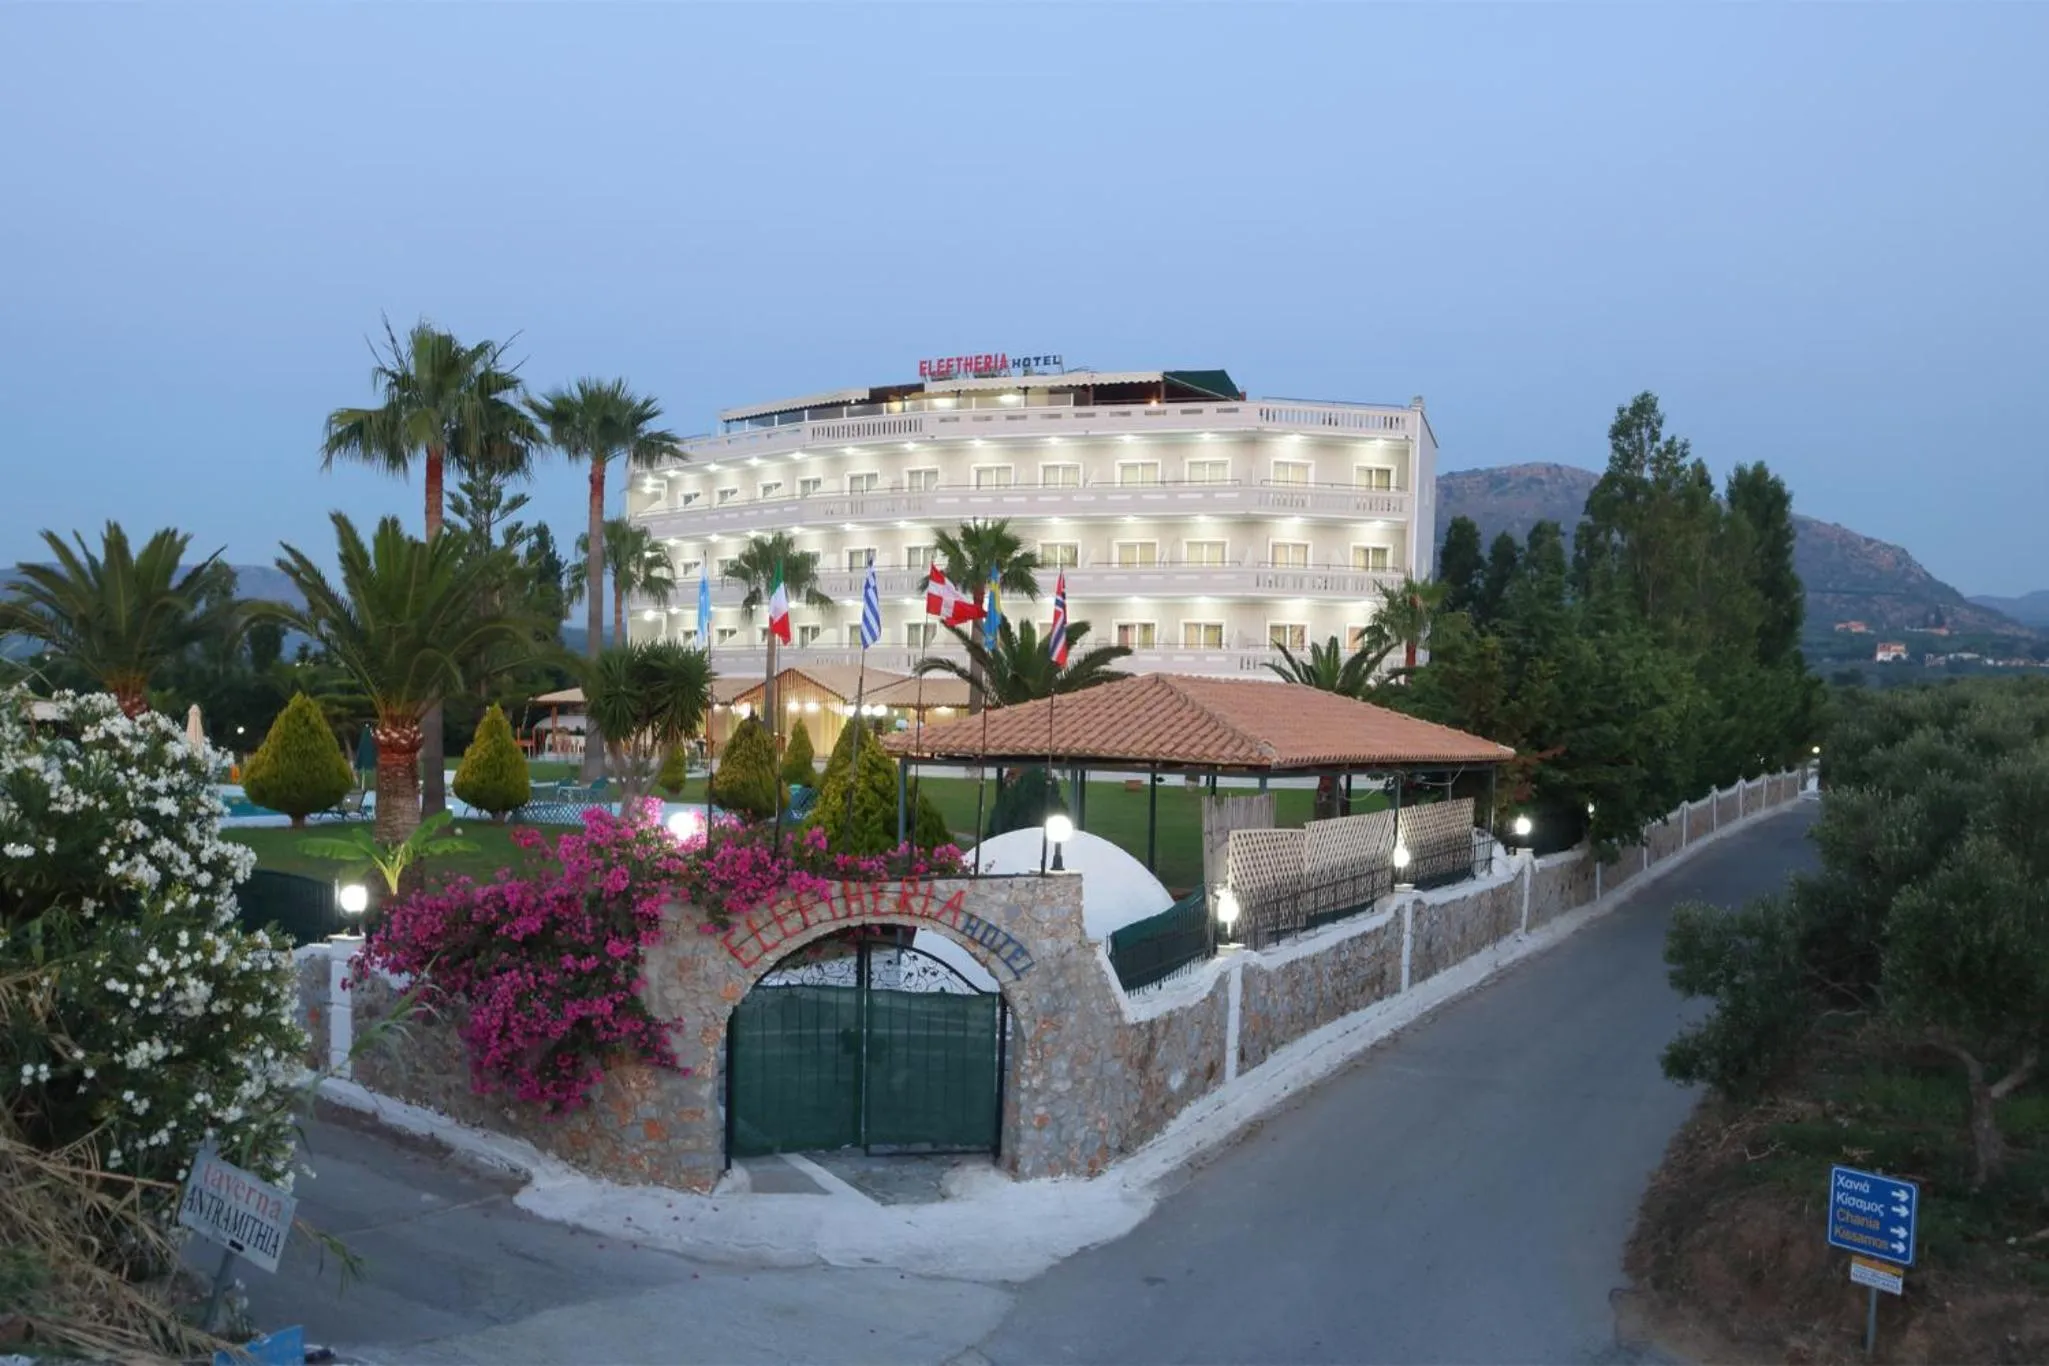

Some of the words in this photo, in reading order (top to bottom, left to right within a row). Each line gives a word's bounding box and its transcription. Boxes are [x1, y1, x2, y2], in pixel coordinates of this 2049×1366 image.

[919, 353, 1008, 376] ELEFTHERIA
[1012, 355, 1060, 369] HOTEL
[962, 913, 1035, 975] HOTEL
[1836, 1174, 1870, 1194] Χανιά
[1836, 1191, 1885, 1217] Κίσαμος
[184, 1183, 281, 1259] ANTRAMITHIA
[1836, 1207, 1881, 1230] Chania
